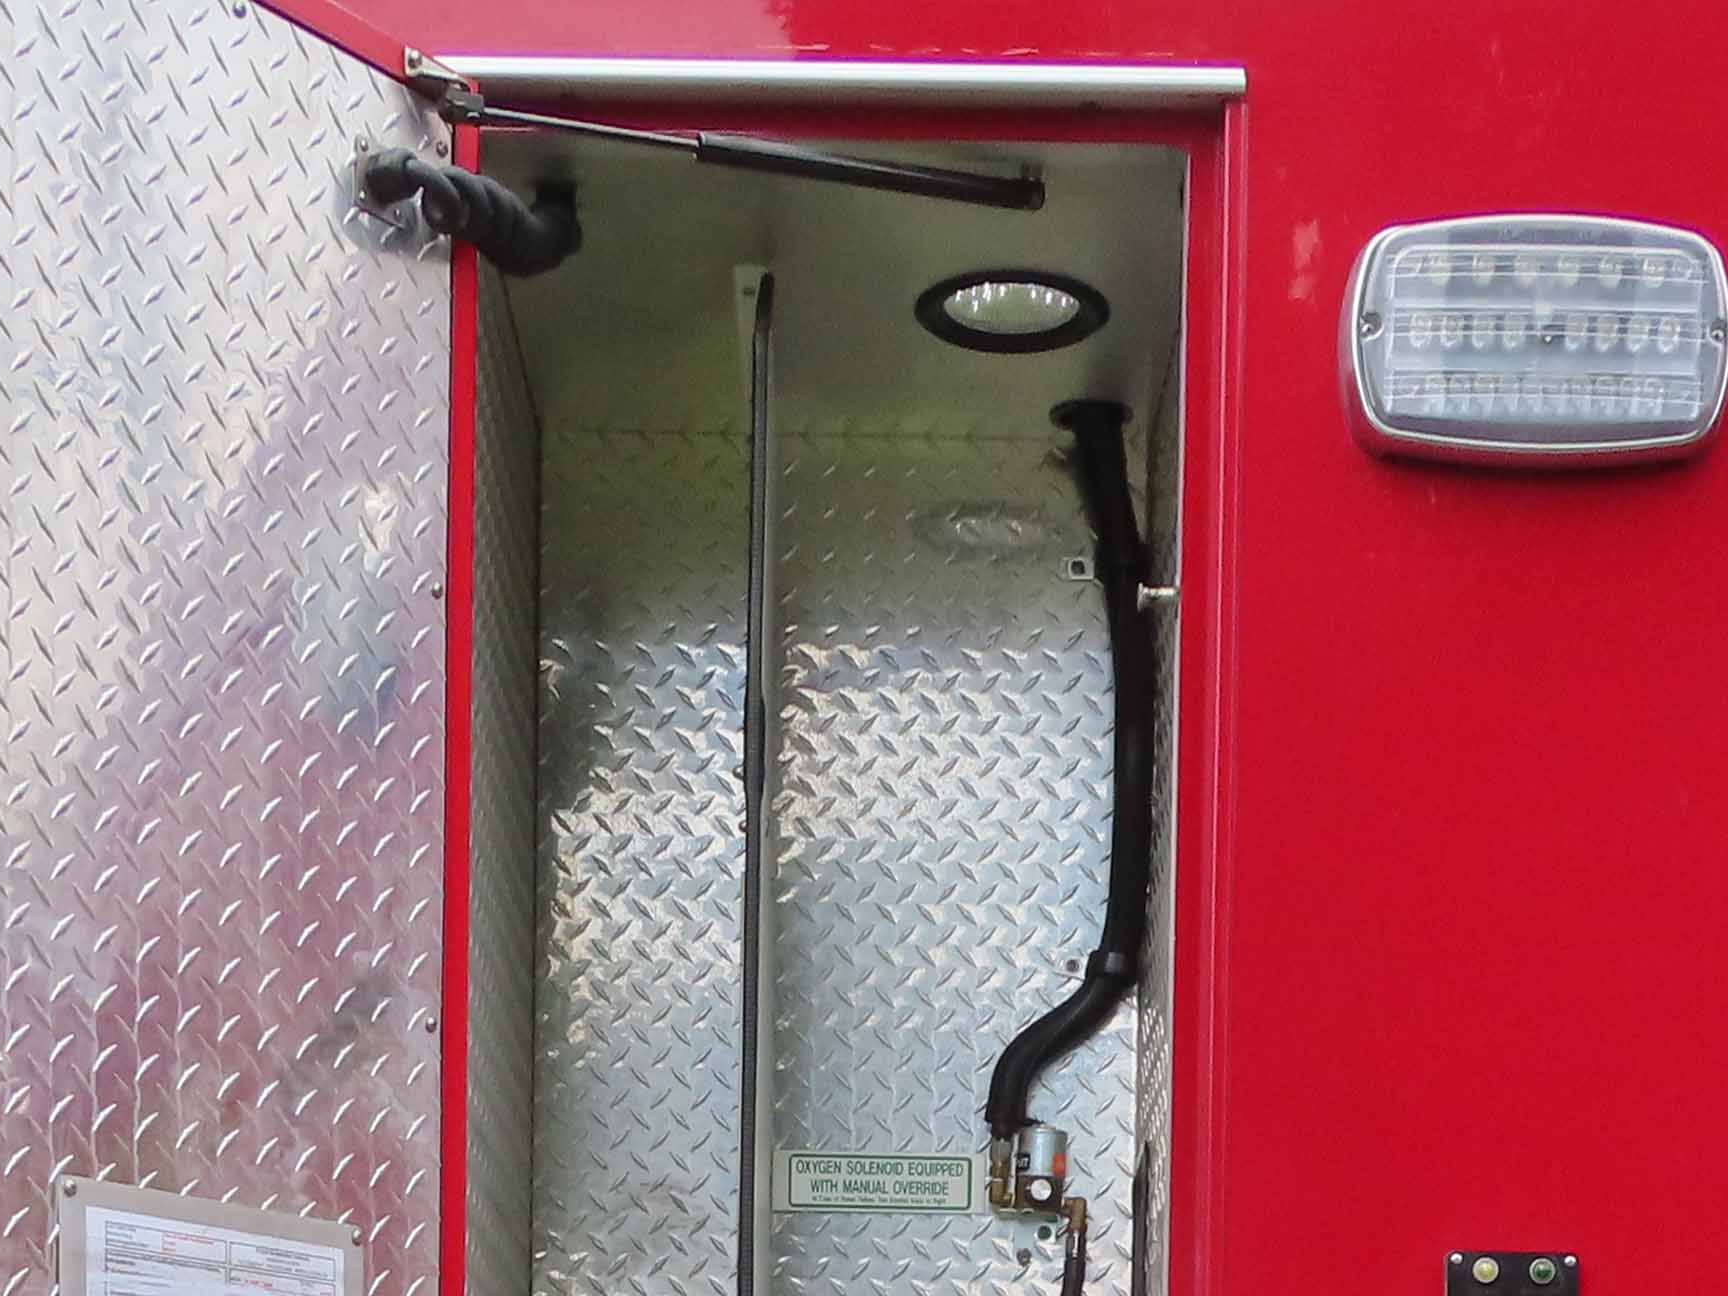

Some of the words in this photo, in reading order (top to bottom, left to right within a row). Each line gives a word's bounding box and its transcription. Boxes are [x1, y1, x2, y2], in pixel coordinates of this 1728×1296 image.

[795, 1160, 842, 1175] OXYGEN
[846, 1160, 904, 1176] SOLENOID
[907, 1161, 964, 1177] EQUIPPED
[810, 1179, 837, 1194] WITH
[842, 1179, 889, 1195] MANUAL
[892, 1180, 949, 1196] OVERRIDE
